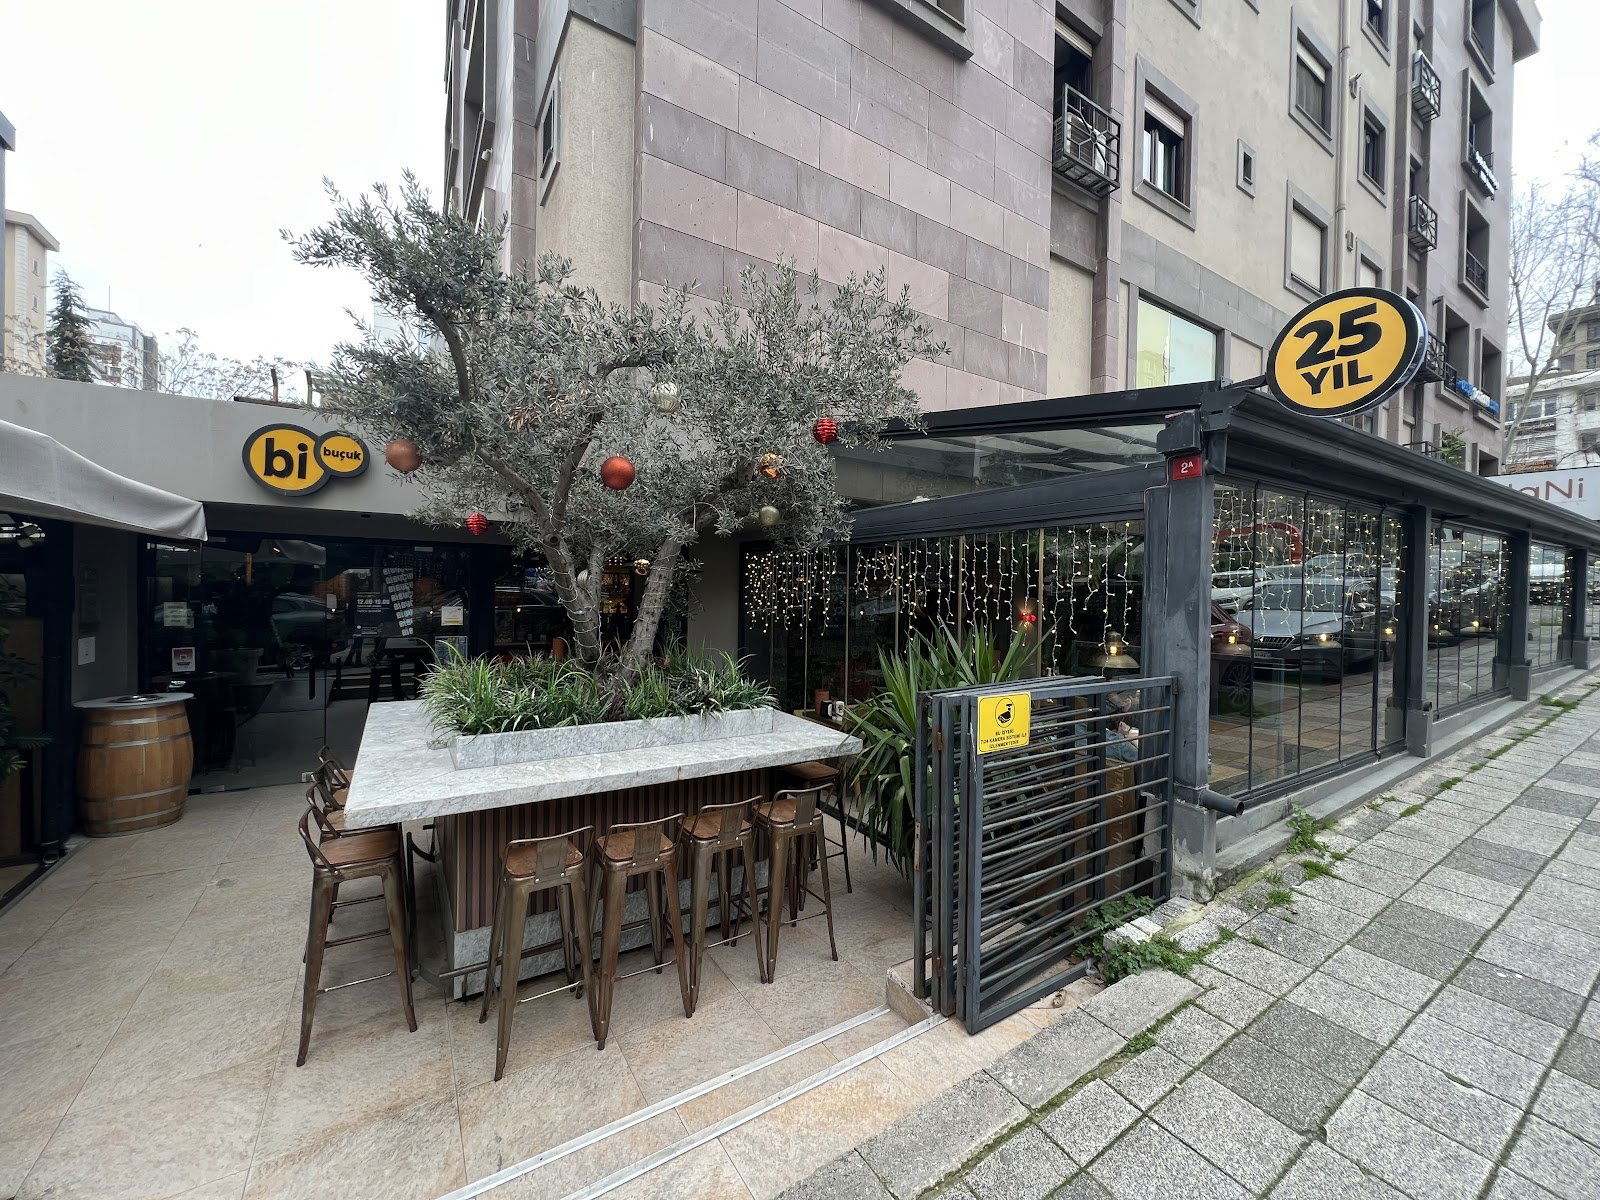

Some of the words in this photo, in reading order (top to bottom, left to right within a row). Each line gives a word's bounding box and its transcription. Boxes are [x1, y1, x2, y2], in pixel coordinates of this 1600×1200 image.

[1293, 302, 1382, 370] 25
[1301, 359, 1373, 395] YIL
[263, 437, 308, 479] bi
[323, 447, 362, 461] buçuk
[1180, 461, 1194, 474] 2A
